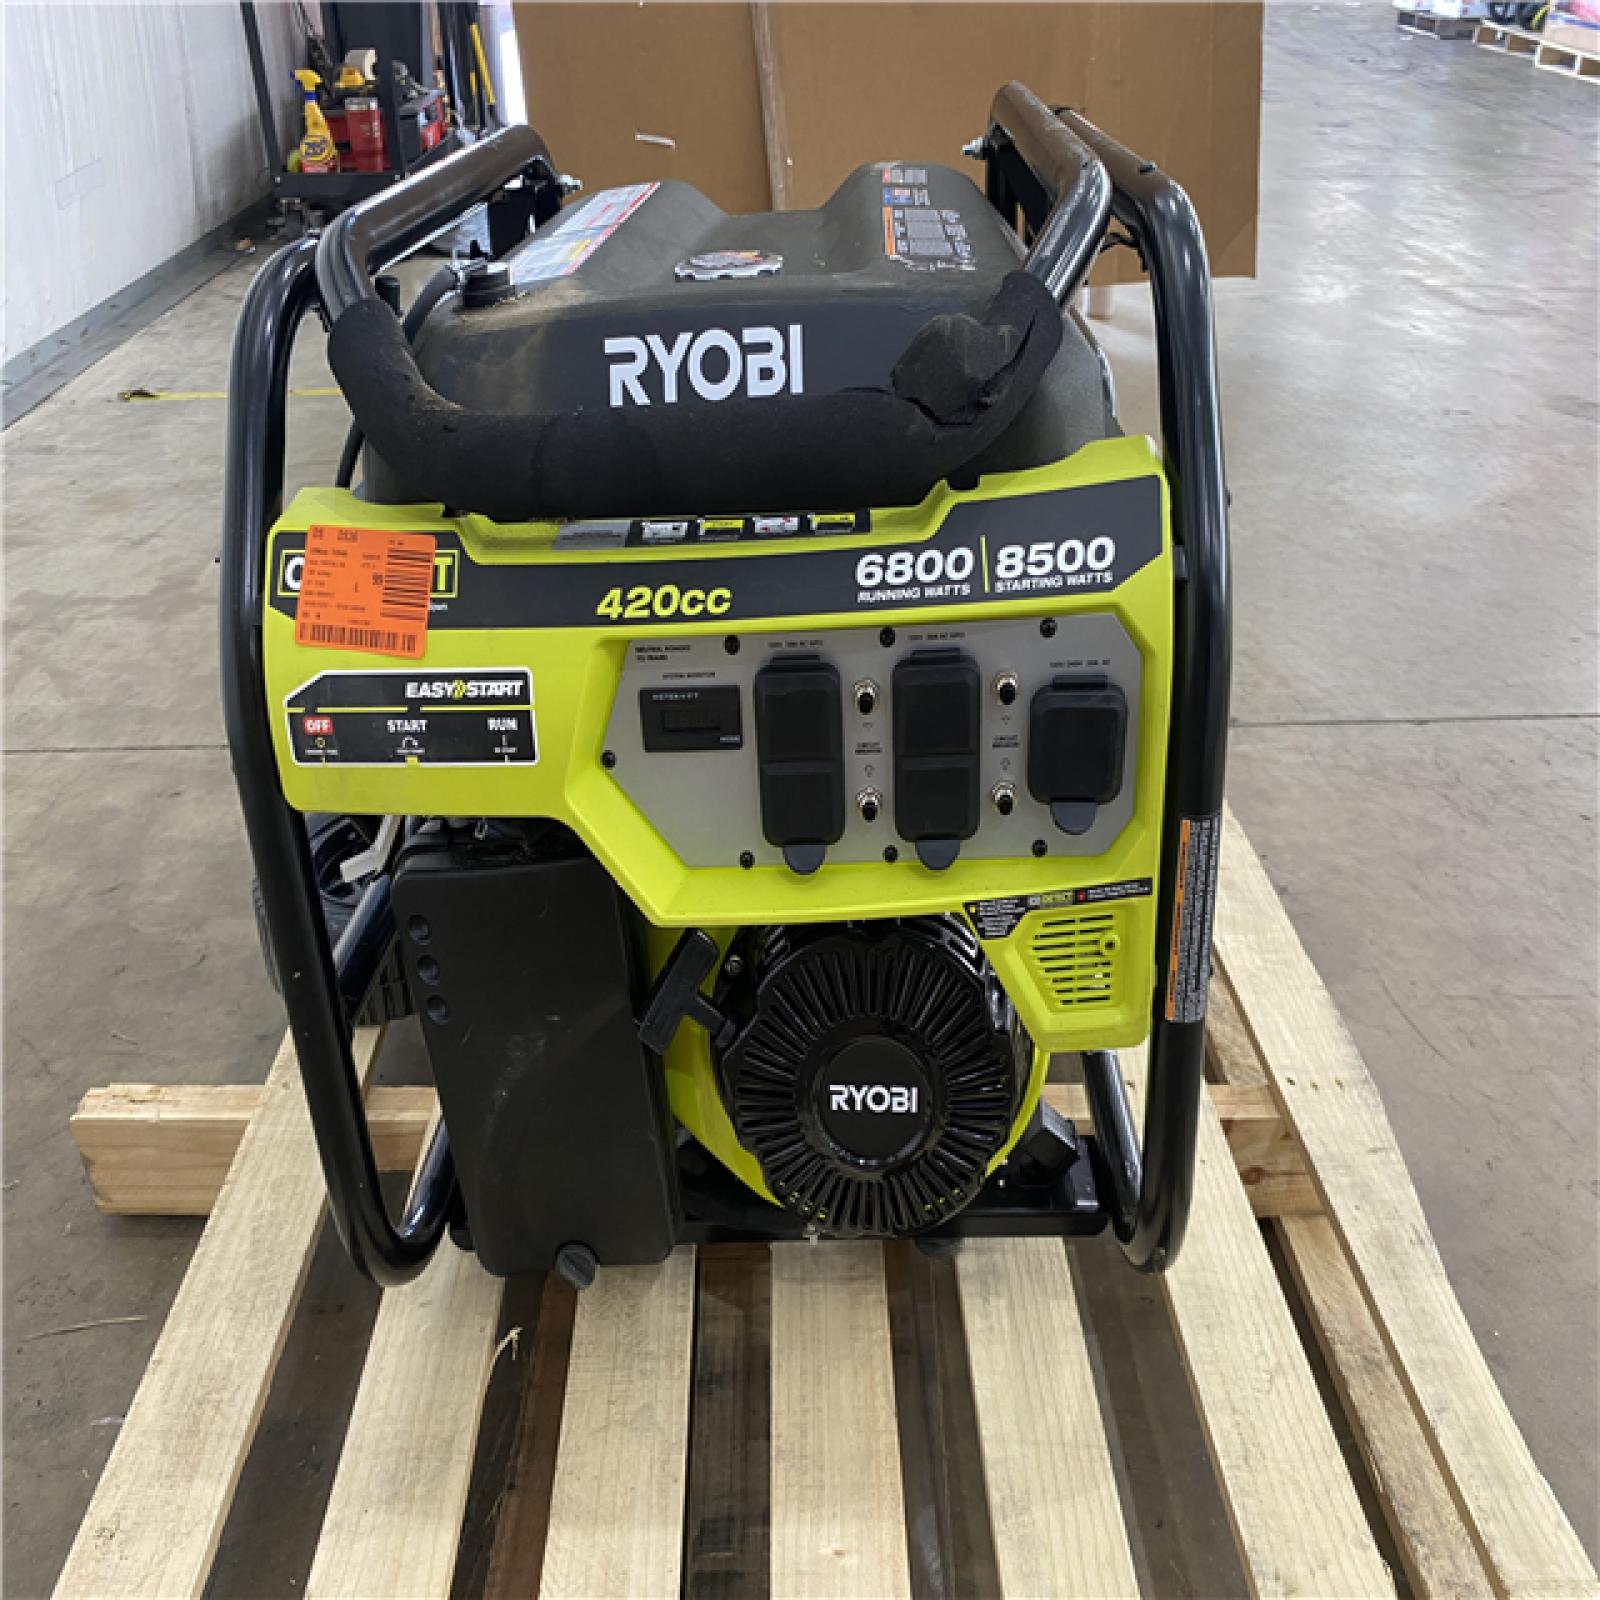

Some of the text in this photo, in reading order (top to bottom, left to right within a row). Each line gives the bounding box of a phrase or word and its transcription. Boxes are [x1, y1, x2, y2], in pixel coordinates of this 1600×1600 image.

[604, 324, 804, 408] RYOBI
[856, 536, 1115, 587] 6800 8500
[995, 571, 1114, 593] STARTING WATTS
[857, 583, 971, 604] RUNNING WATTS
[405, 679, 524, 699] EASY START
[307, 720, 330, 732] OFF
[386, 719, 428, 734] START
[487, 717, 519, 731] RUN
[829, 1084, 919, 1114] RYOBI
